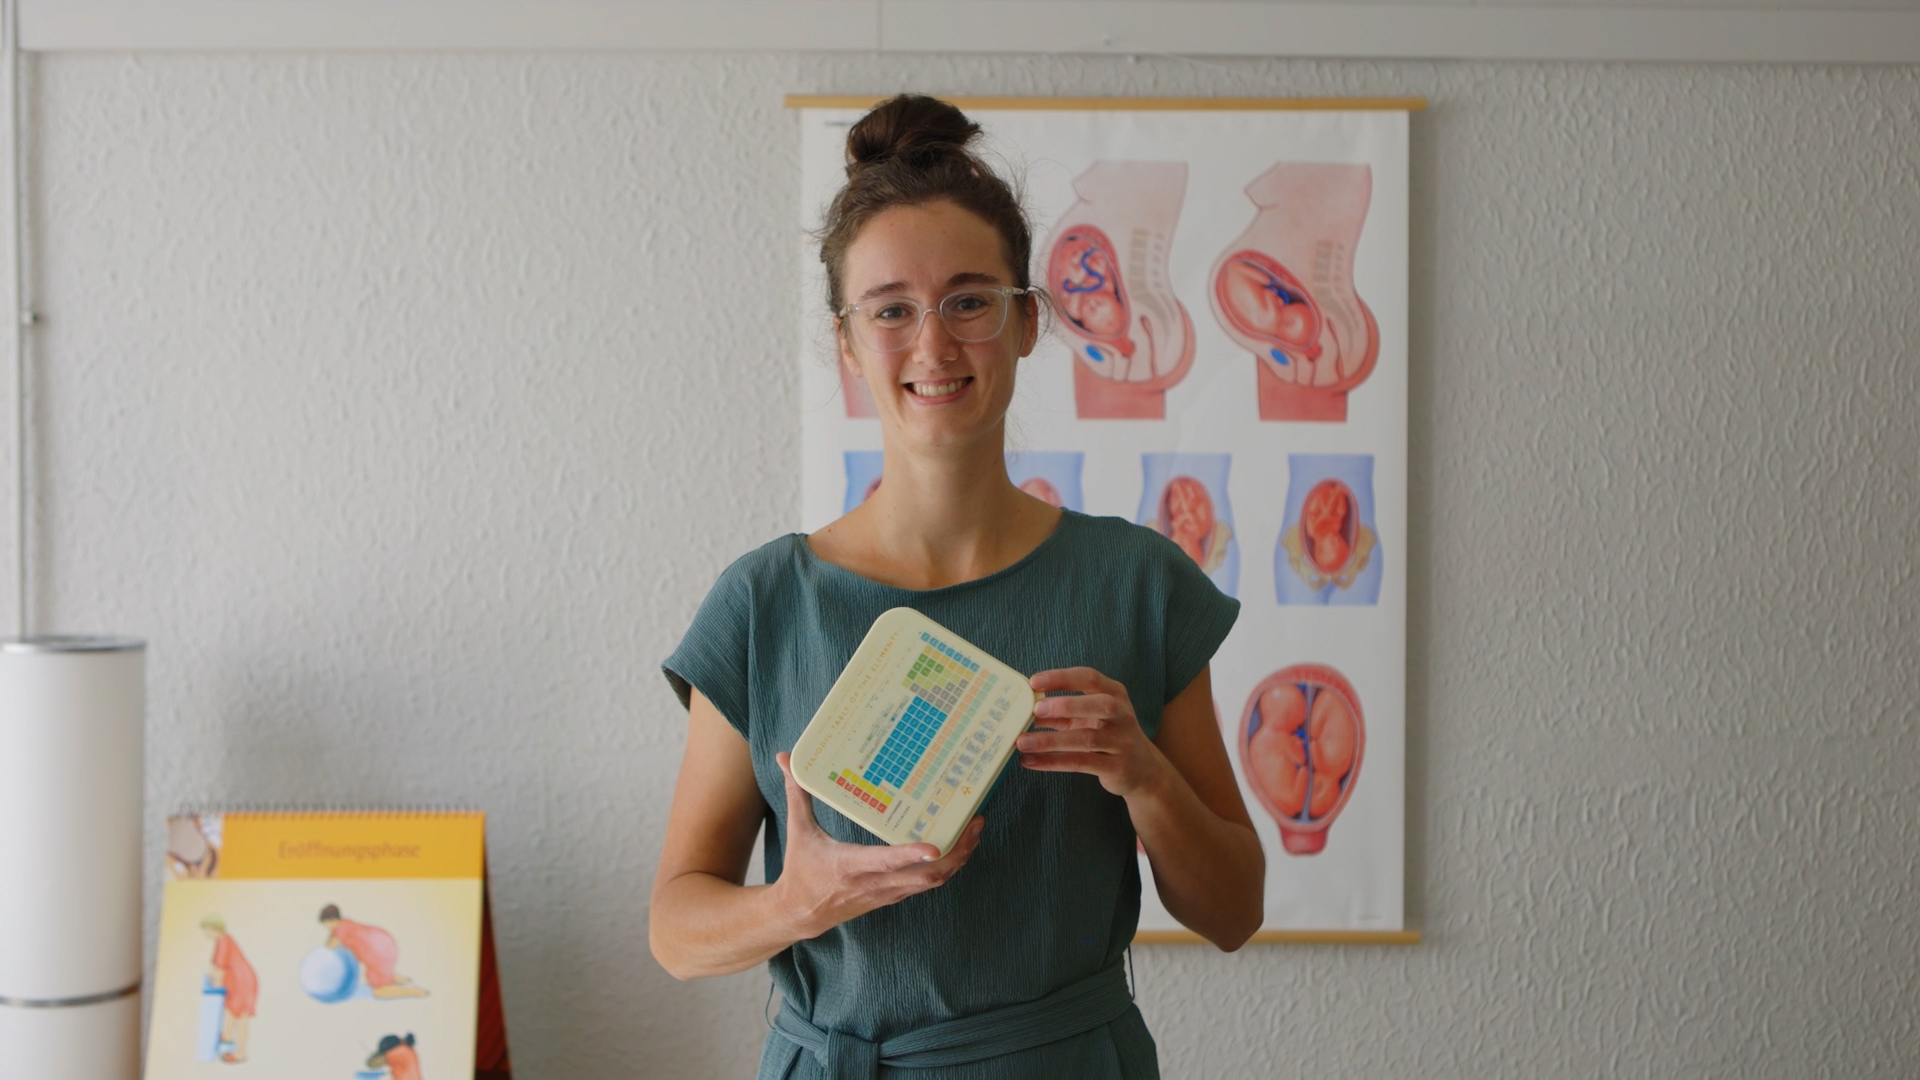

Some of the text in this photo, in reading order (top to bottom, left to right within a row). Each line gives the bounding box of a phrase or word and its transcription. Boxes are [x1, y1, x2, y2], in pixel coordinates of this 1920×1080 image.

[831, 706, 850, 730] TABLE
[849, 691, 859, 704] OF
[278, 840, 421, 862] Eröffnungsphase
